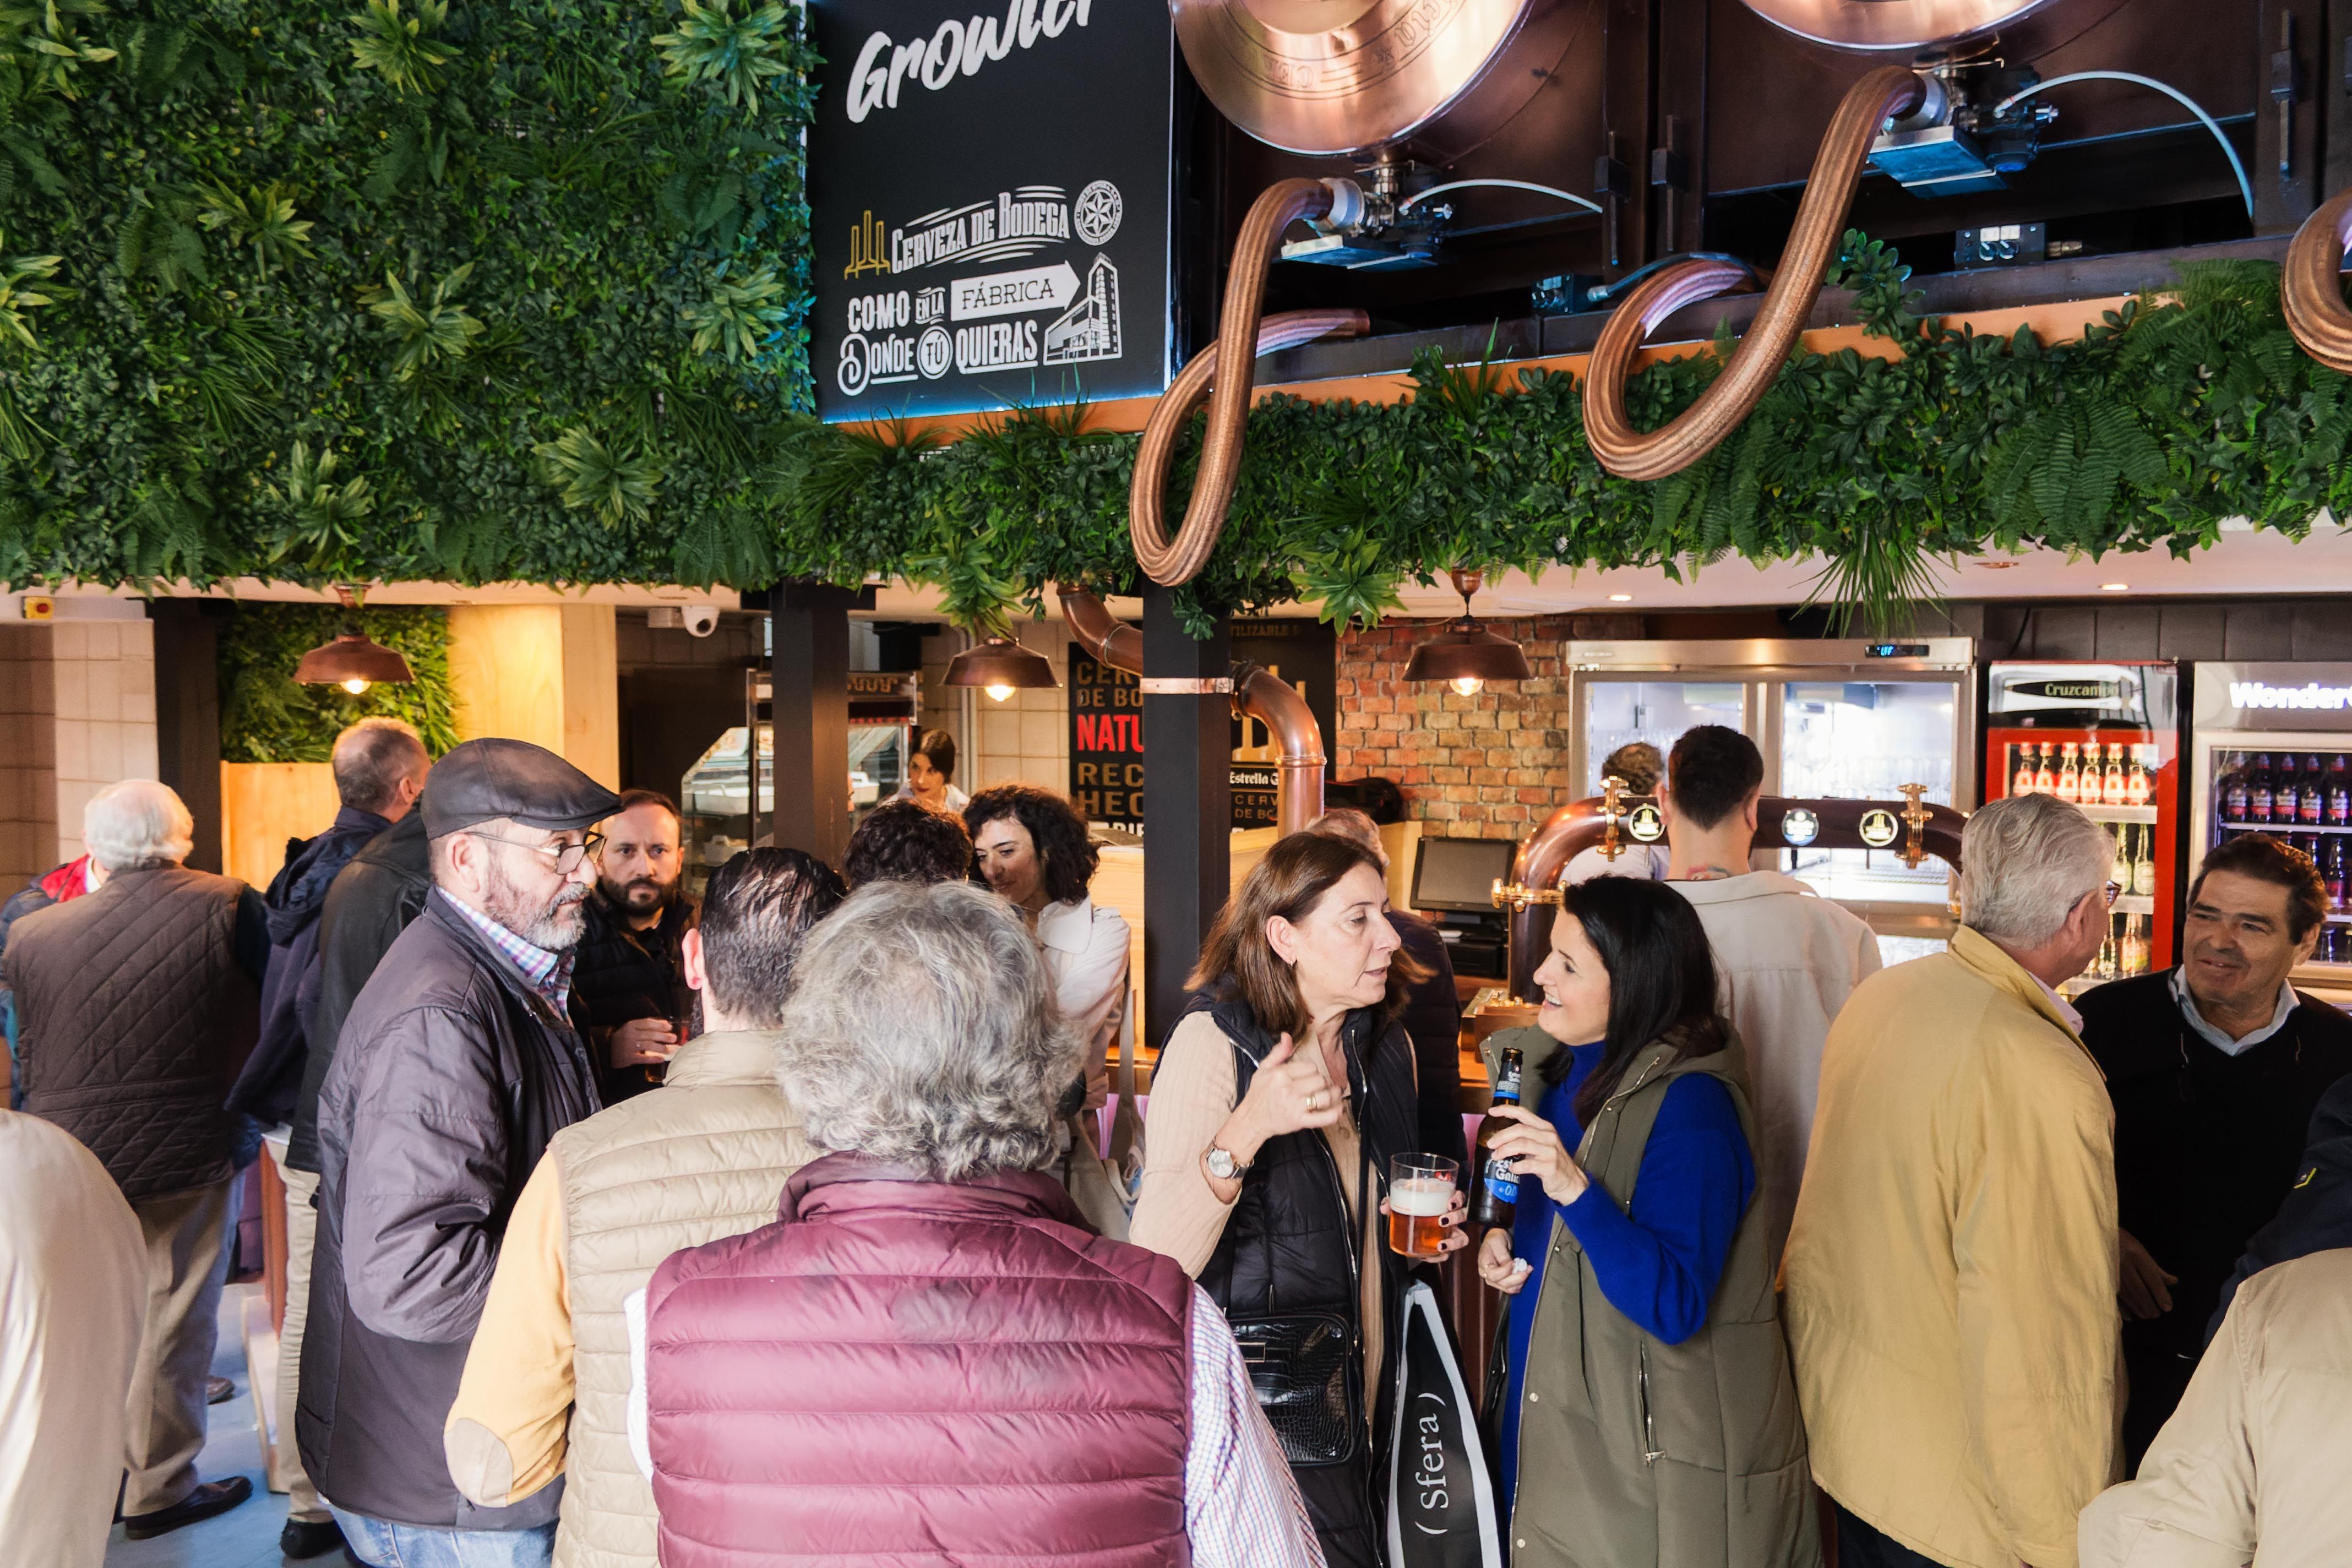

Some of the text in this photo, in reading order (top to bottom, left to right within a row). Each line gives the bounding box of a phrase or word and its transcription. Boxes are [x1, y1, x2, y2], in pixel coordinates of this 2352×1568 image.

[892, 218, 967, 274] CERVEZA
[971, 208, 995, 246] DE
[998, 192, 1070, 239] BODEGA
[848, 279, 1054, 332] COMO EN LA FÁBRICA
[837, 319, 1038, 396] DONDE TÚ QUIERAS
[1077, 688, 1106, 707] DE
[1230, 771, 1268, 785] Estrella
